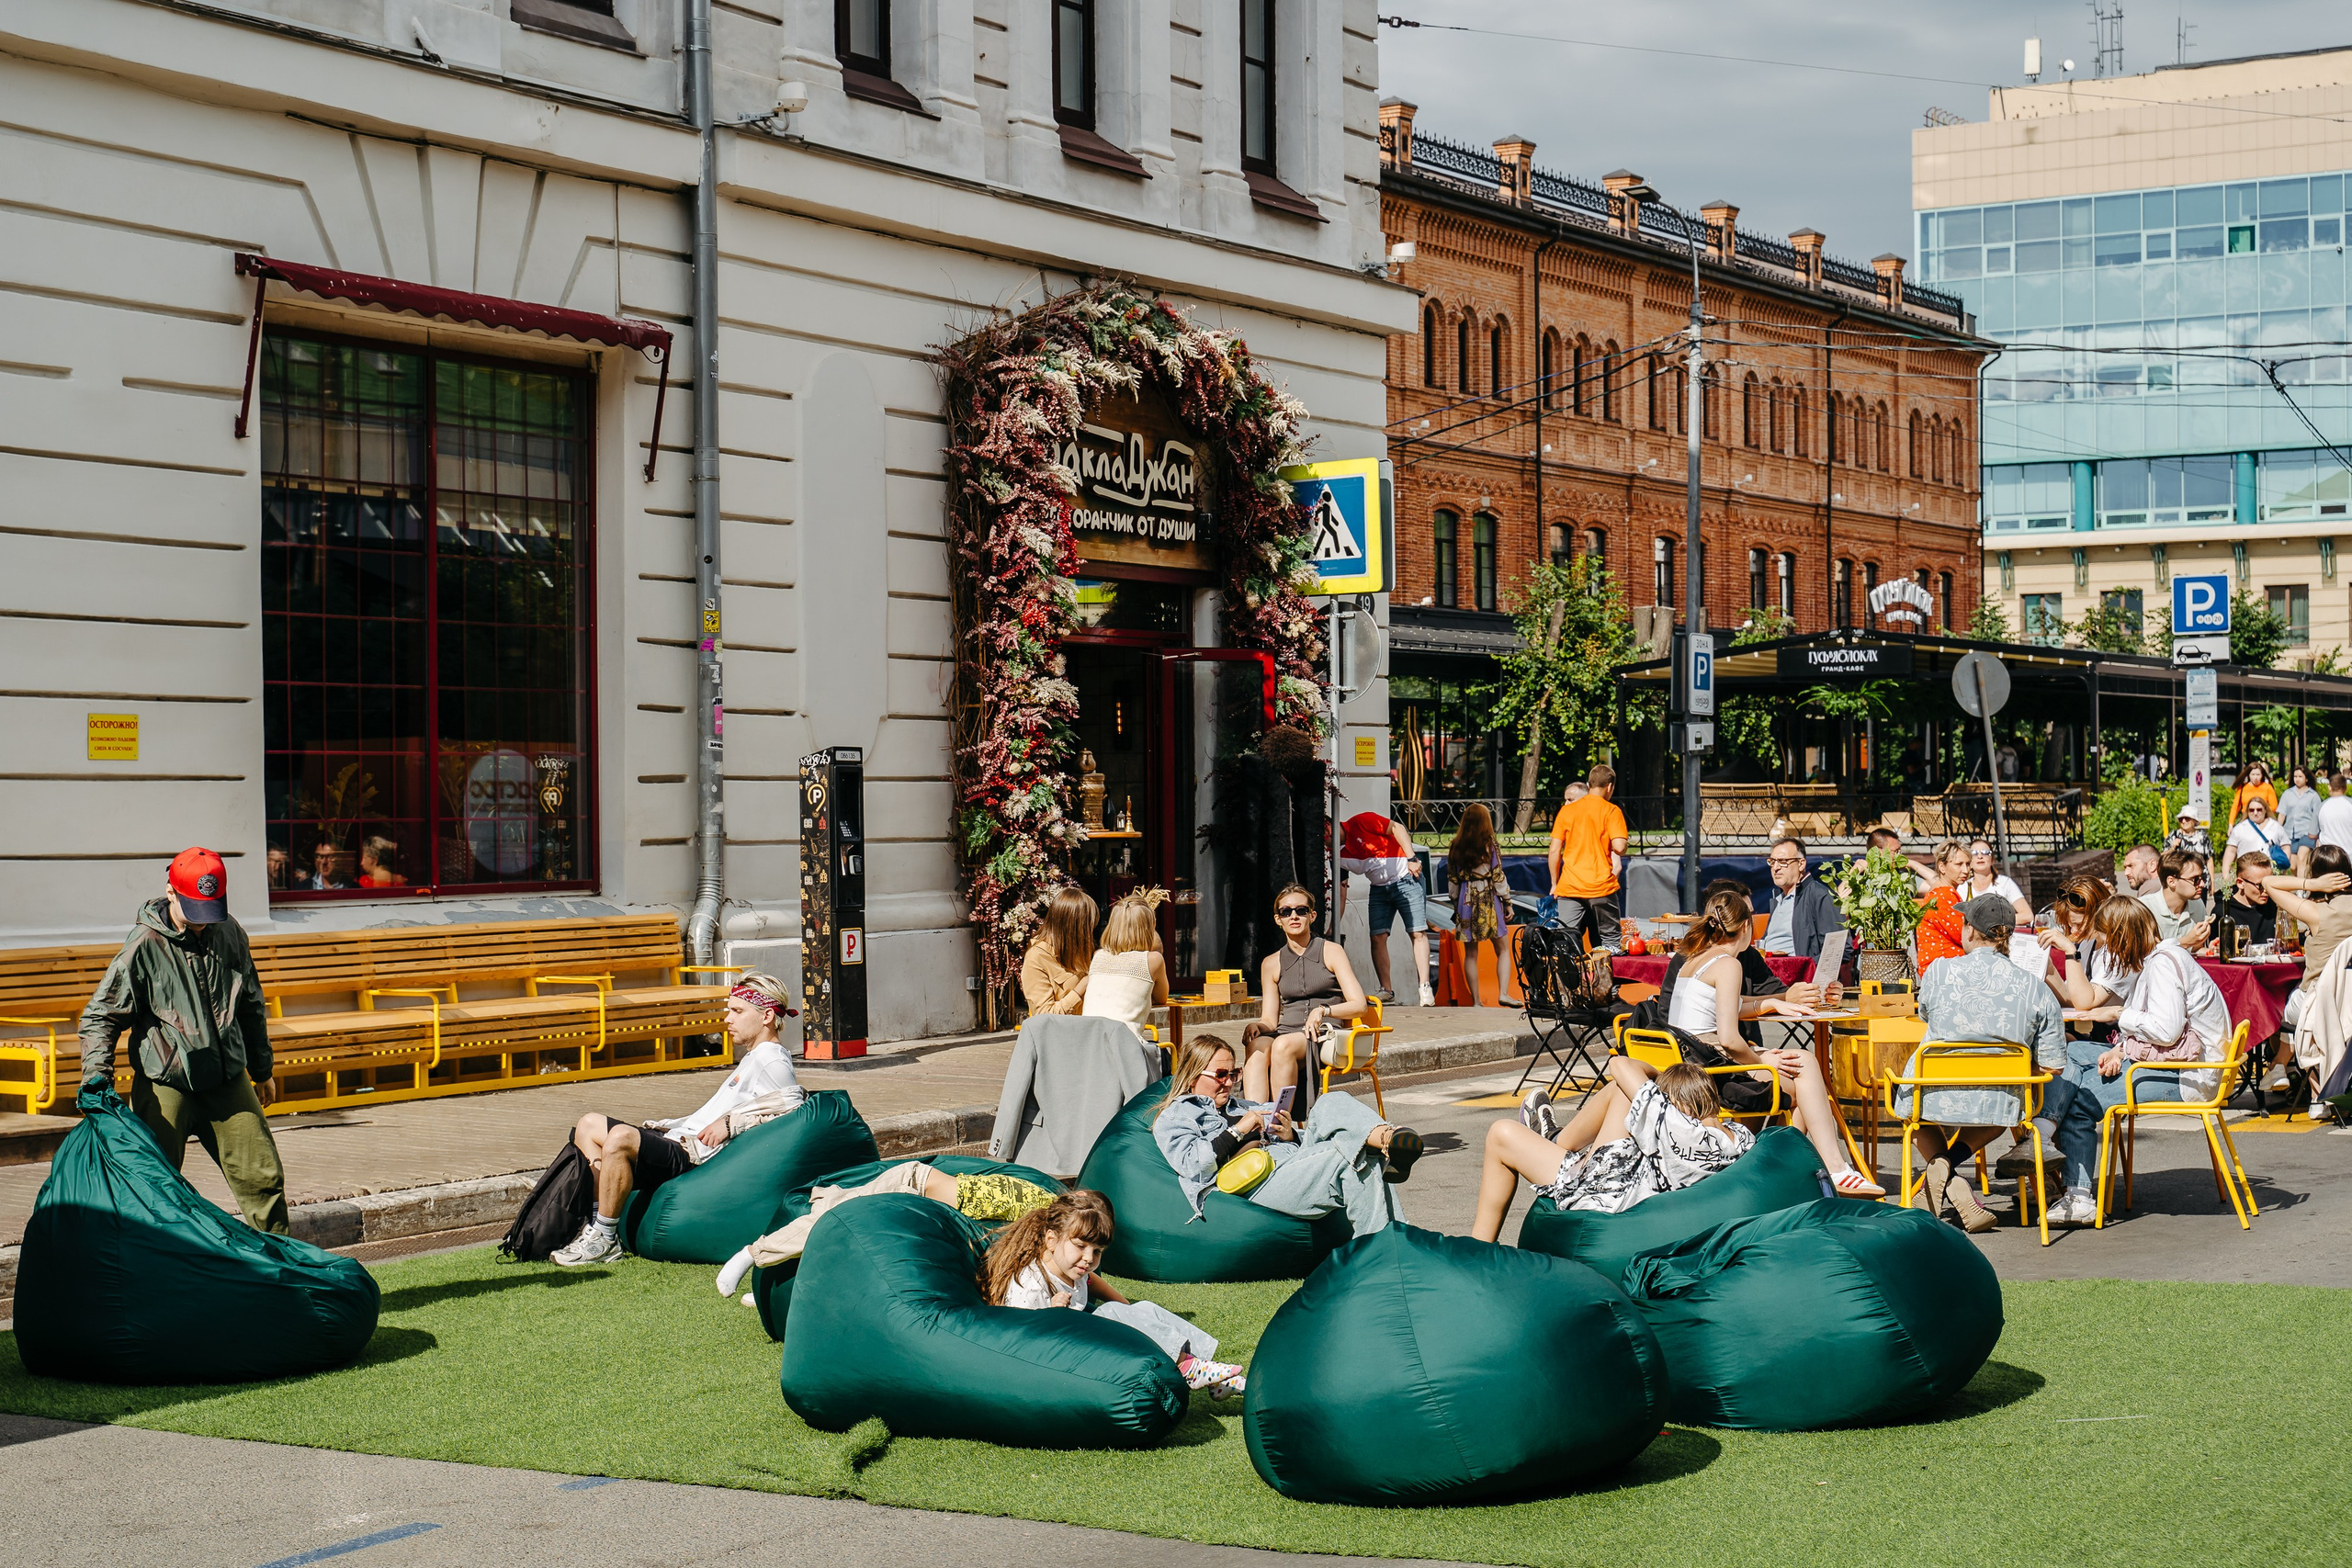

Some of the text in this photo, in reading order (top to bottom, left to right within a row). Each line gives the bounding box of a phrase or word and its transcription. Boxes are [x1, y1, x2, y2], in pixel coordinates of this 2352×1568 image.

[1136, 515, 1155, 536] ОТ
[1157, 517, 1195, 542] ДУШИ
[1361, 595, 1371, 613] 19
[2186, 581, 2216, 627] P
[1696, 639, 1709, 649] ЗОНА
[1697, 656, 1708, 686] P
[89, 720, 138, 729] ОСТОРОЖНО!
[813, 789, 822, 803] P
